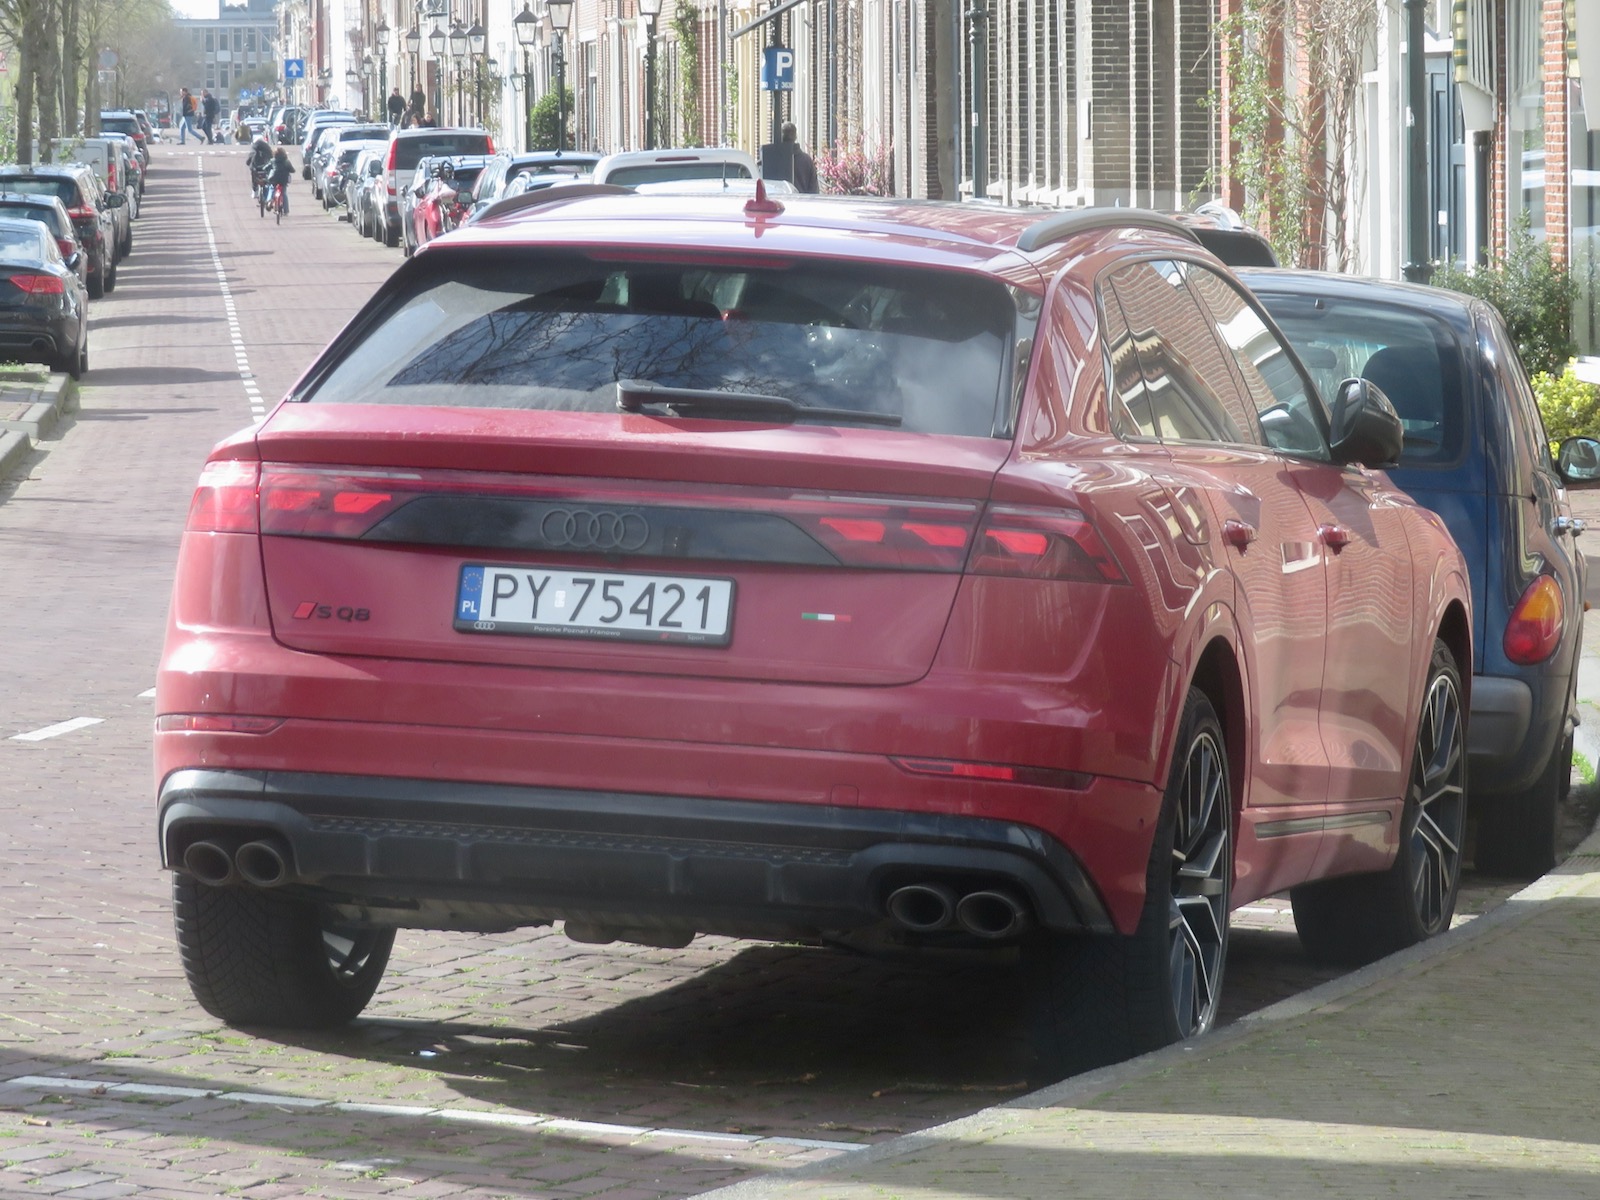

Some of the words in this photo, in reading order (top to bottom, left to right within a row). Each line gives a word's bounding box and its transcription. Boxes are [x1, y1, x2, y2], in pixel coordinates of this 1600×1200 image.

[776, 51, 793, 77] P
[462, 600, 478, 613] PL
[490, 573, 551, 619] PY
[569, 578, 711, 630] 75421
[533, 625, 561, 633] Porsche
